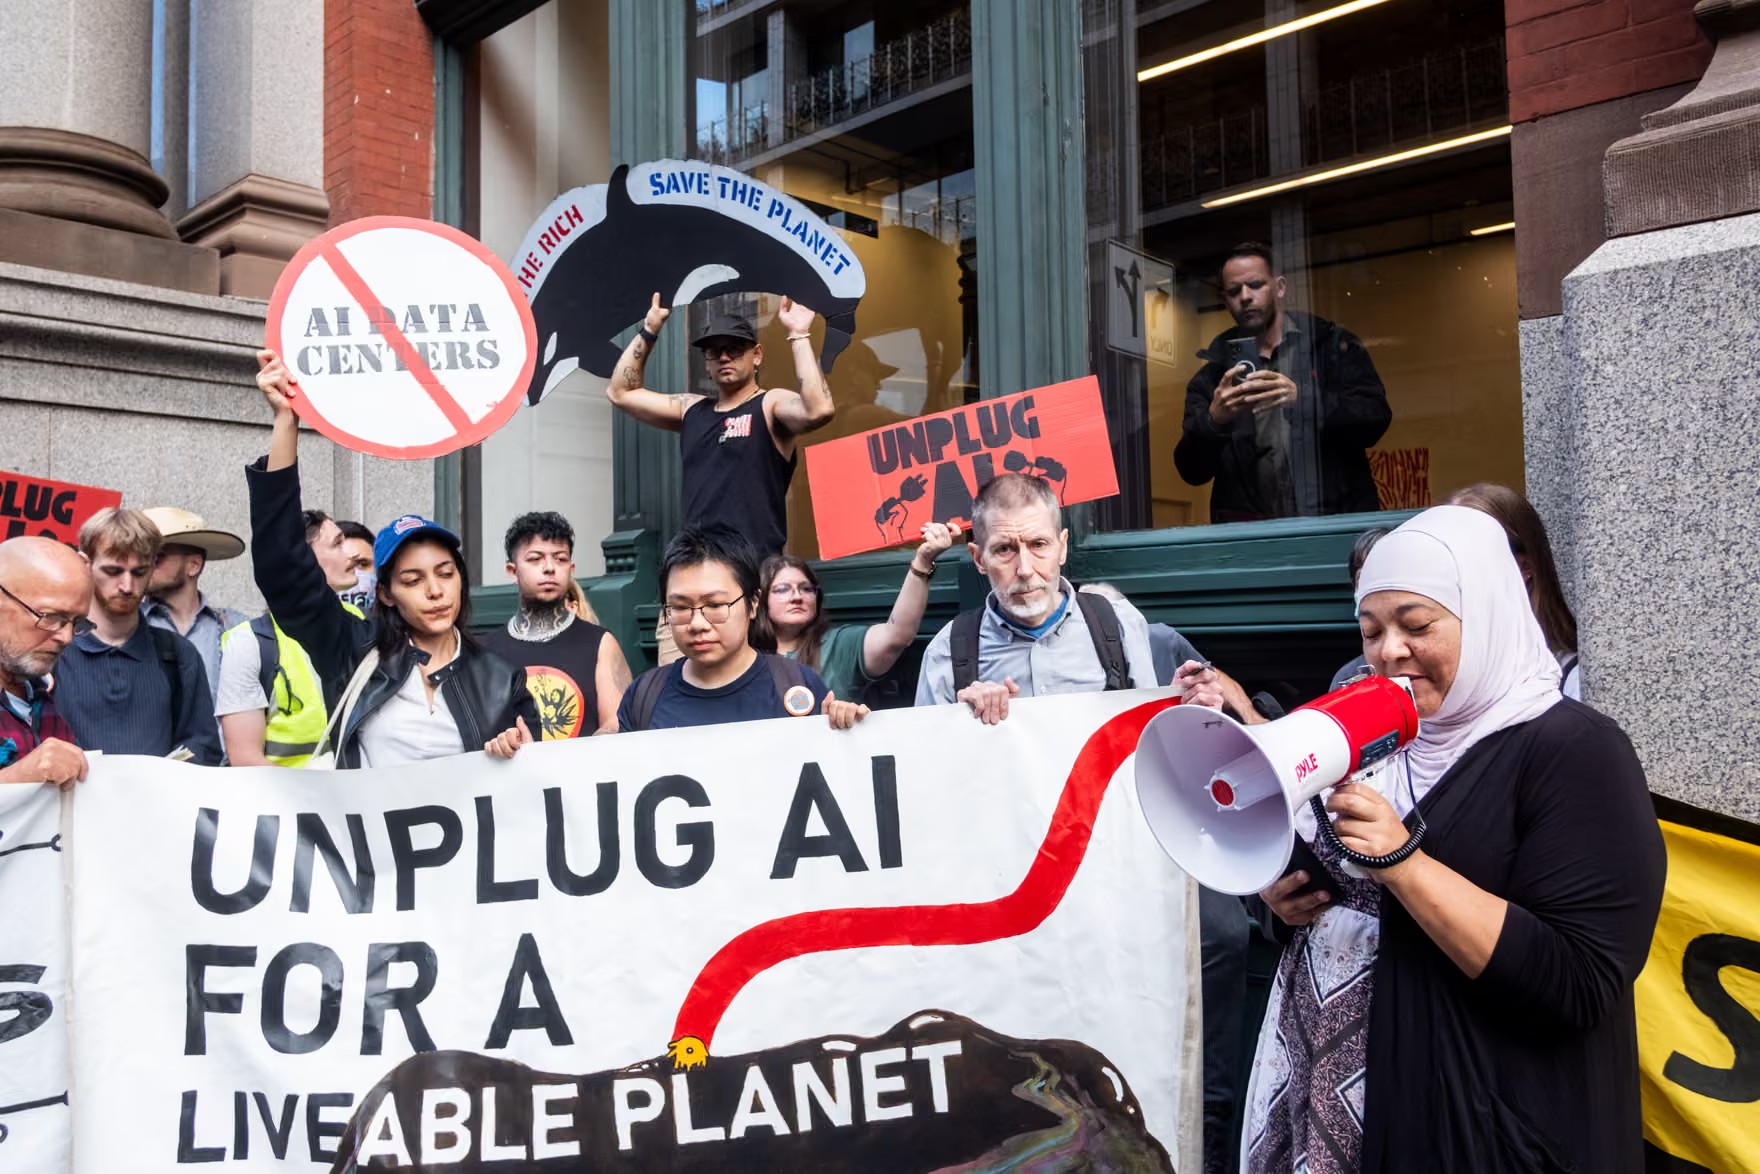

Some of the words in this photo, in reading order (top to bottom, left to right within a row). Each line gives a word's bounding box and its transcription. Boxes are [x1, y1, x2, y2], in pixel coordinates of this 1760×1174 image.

[518, 252, 544, 298] HE
[538, 204, 584, 255] RICH
[650, 171, 710, 196] SAVE
[717, 176, 764, 211] THE
[767, 198, 851, 275] PLANET
[297, 339, 501, 376] CENTERS
[304, 306, 352, 337] AI
[368, 303, 491, 335] DATA
[867, 396, 1041, 475] UNPLUG
[0, 480, 78, 525] LUG
[1294, 753, 1319, 783] PYLE
[191, 774, 715, 915] UNPLUG
[769, 755, 903, 880] AI
[184, 941, 438, 1056] FOR
[484, 933, 575, 1049] A
[177, 1083, 581, 1167] LIVEABLE
[612, 1039, 963, 1151] PLANET
